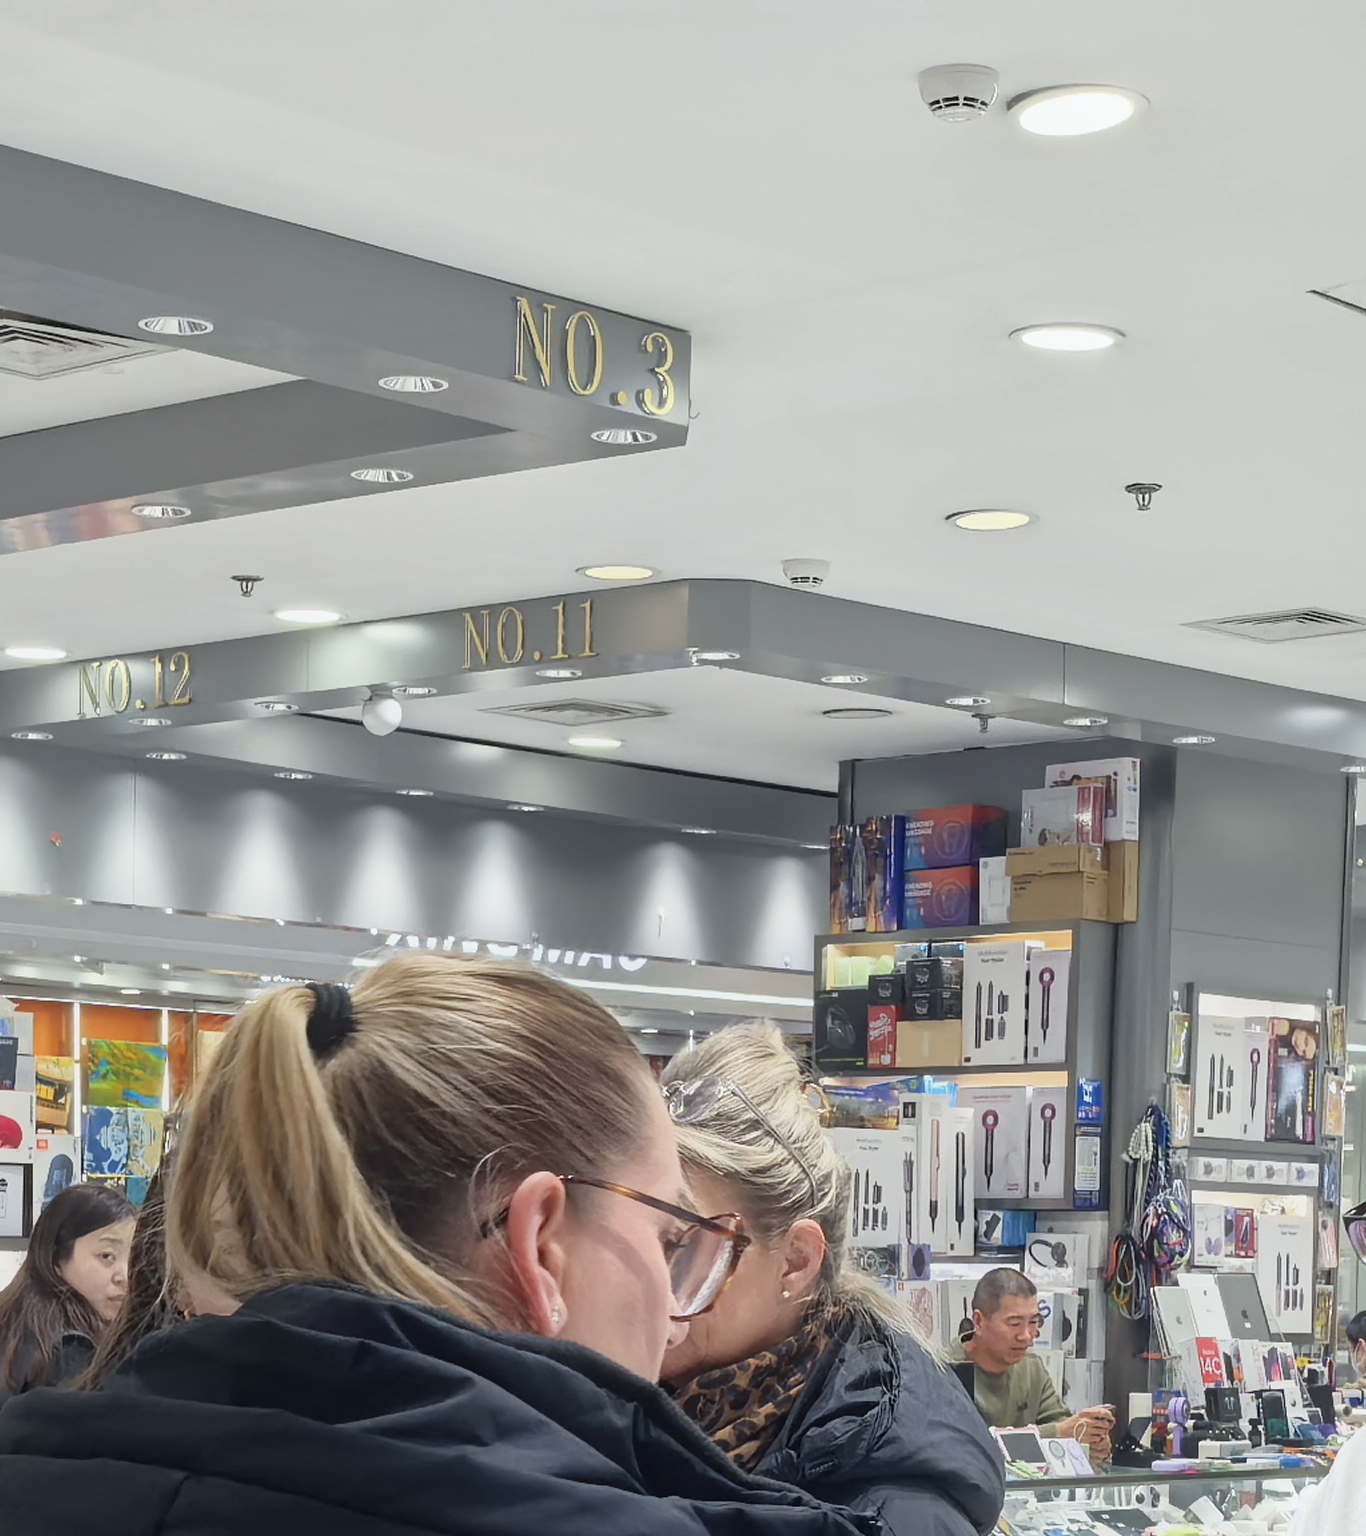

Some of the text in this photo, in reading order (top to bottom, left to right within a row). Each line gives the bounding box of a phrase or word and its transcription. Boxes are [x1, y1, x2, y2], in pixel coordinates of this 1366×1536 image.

[512, 295, 677, 416] NO.3
[462, 599, 598, 670] NO.11
[78, 651, 192, 717] NO.12
